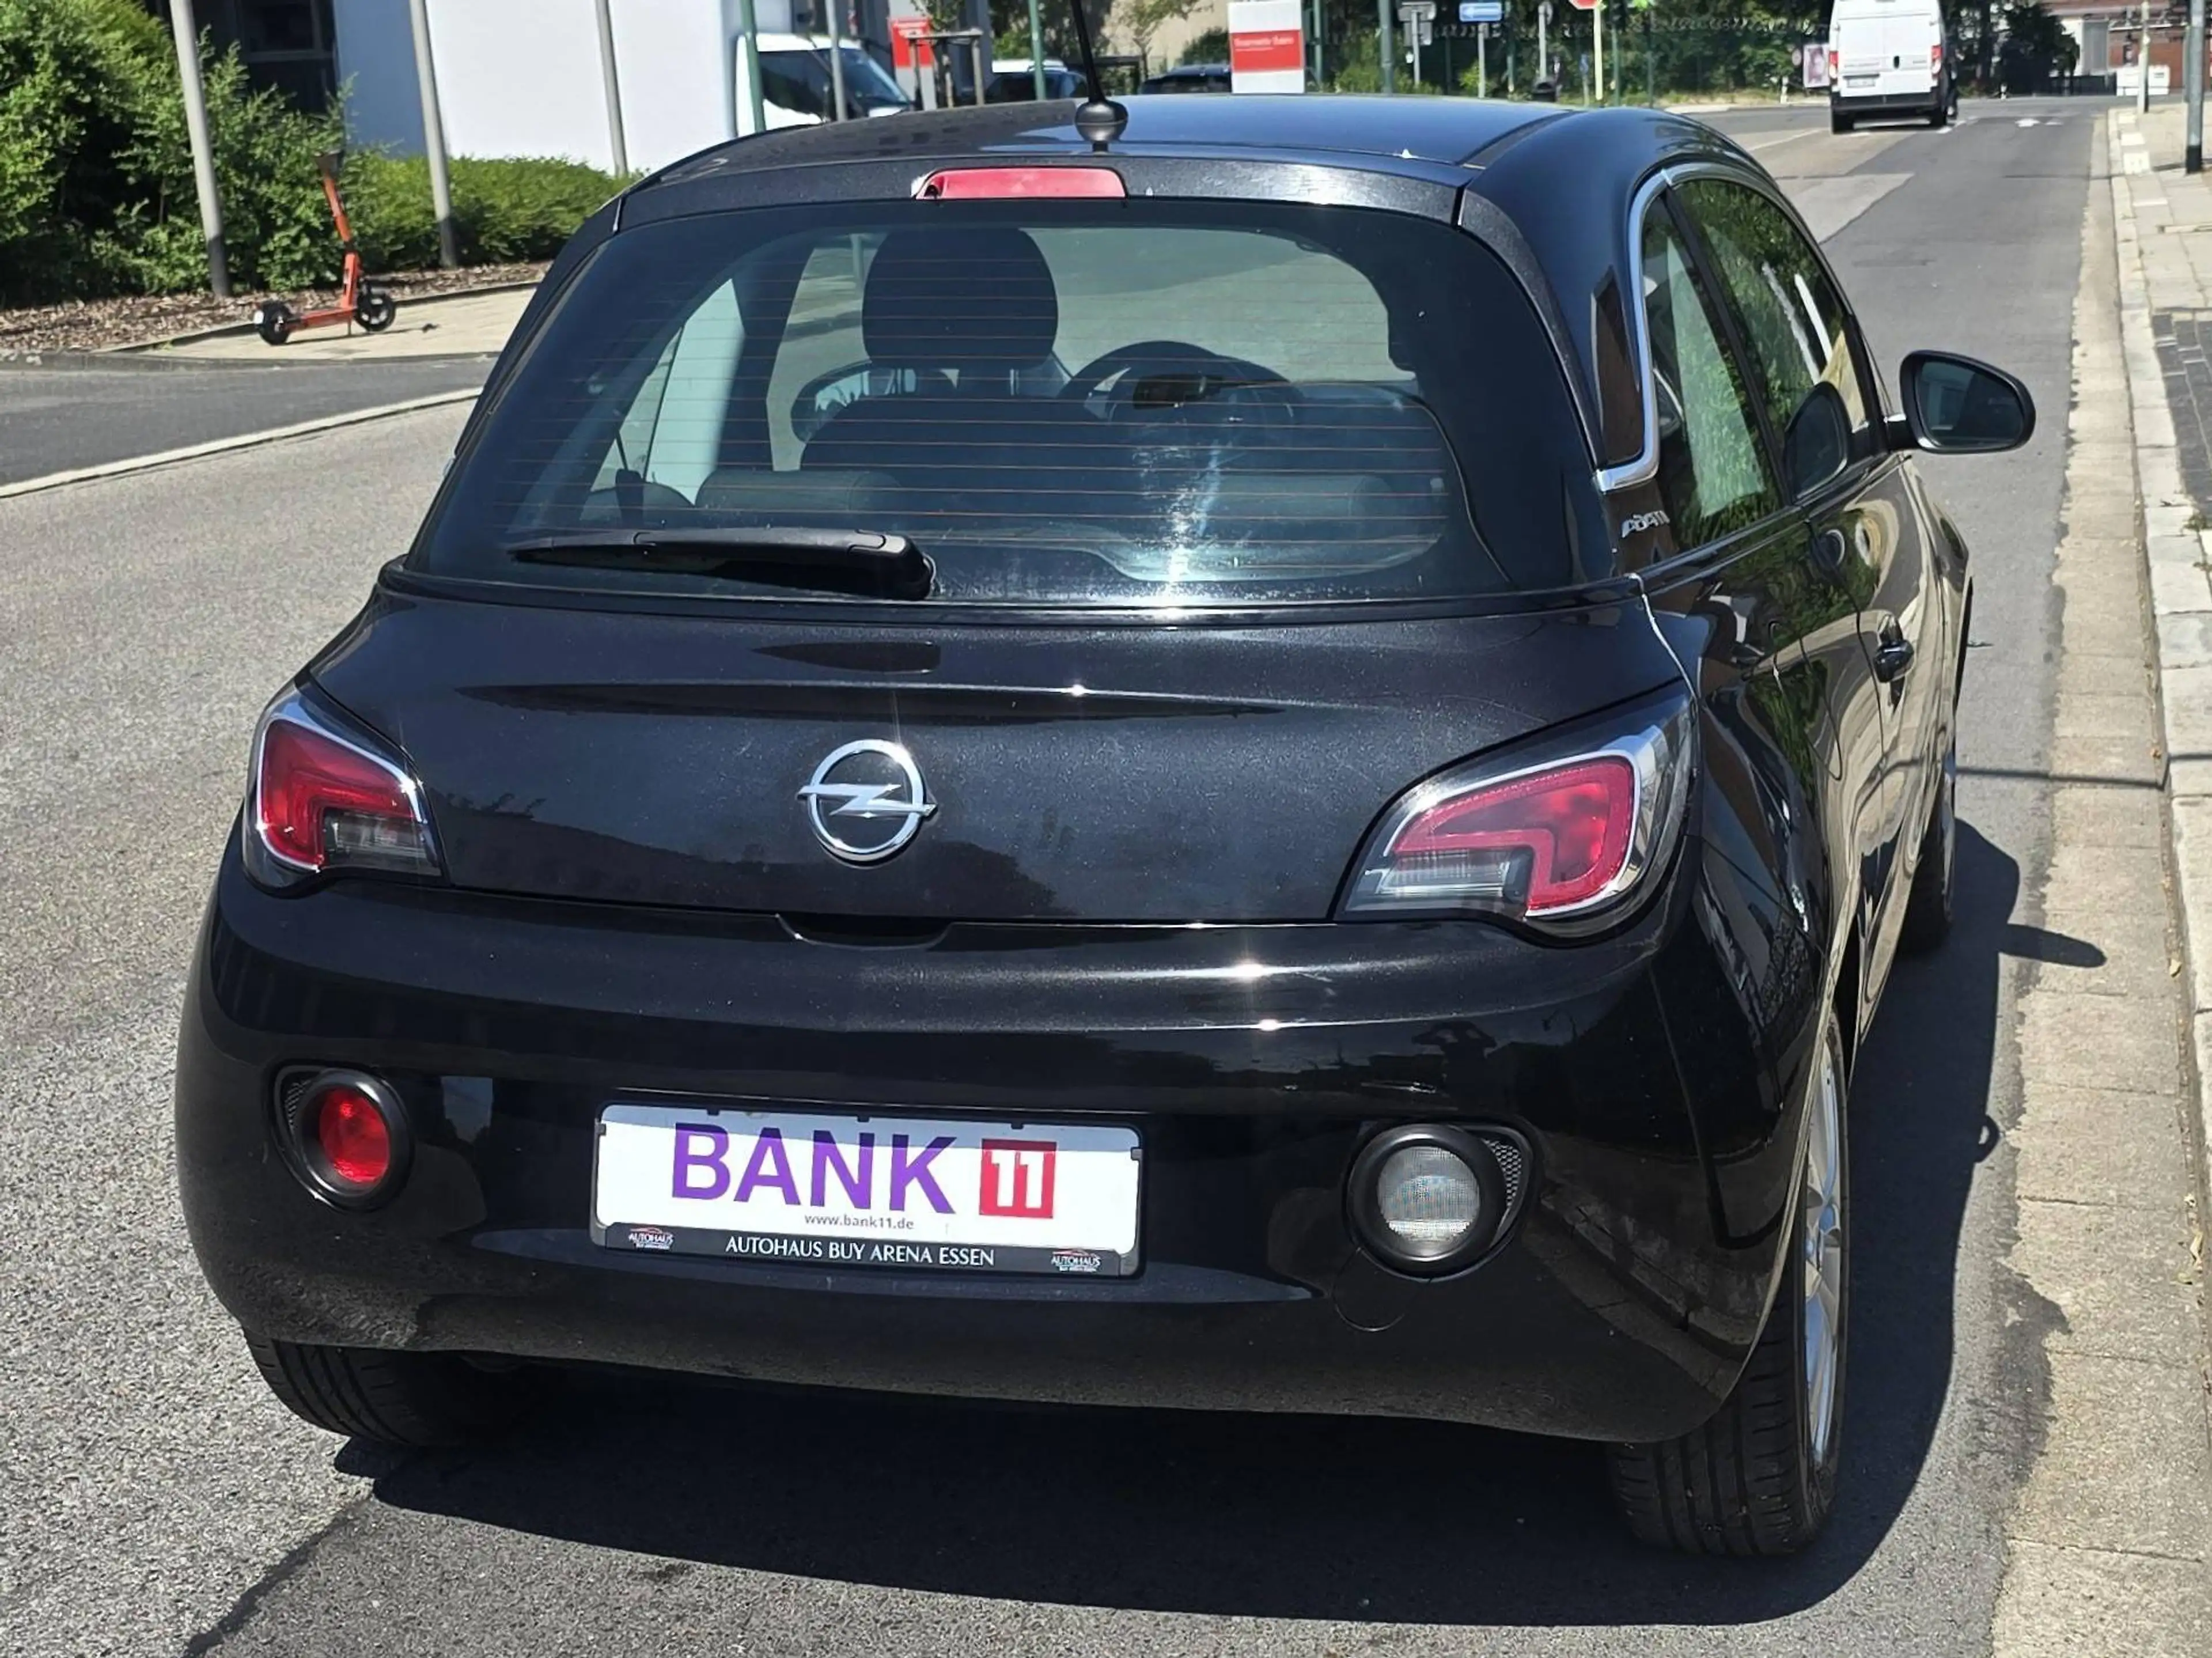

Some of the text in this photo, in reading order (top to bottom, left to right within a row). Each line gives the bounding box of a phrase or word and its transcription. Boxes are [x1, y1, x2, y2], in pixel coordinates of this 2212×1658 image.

[672, 1122, 1044, 1214] BANK 11
[805, 1214, 914, 1229] www.bank11.de
[628, 1232, 674, 1246] AUTOHAUS
[725, 1236, 995, 1266] AUTOHAUS BUY ARENA ESSEN
[1051, 1254, 1102, 1267] AUTOHAUS
